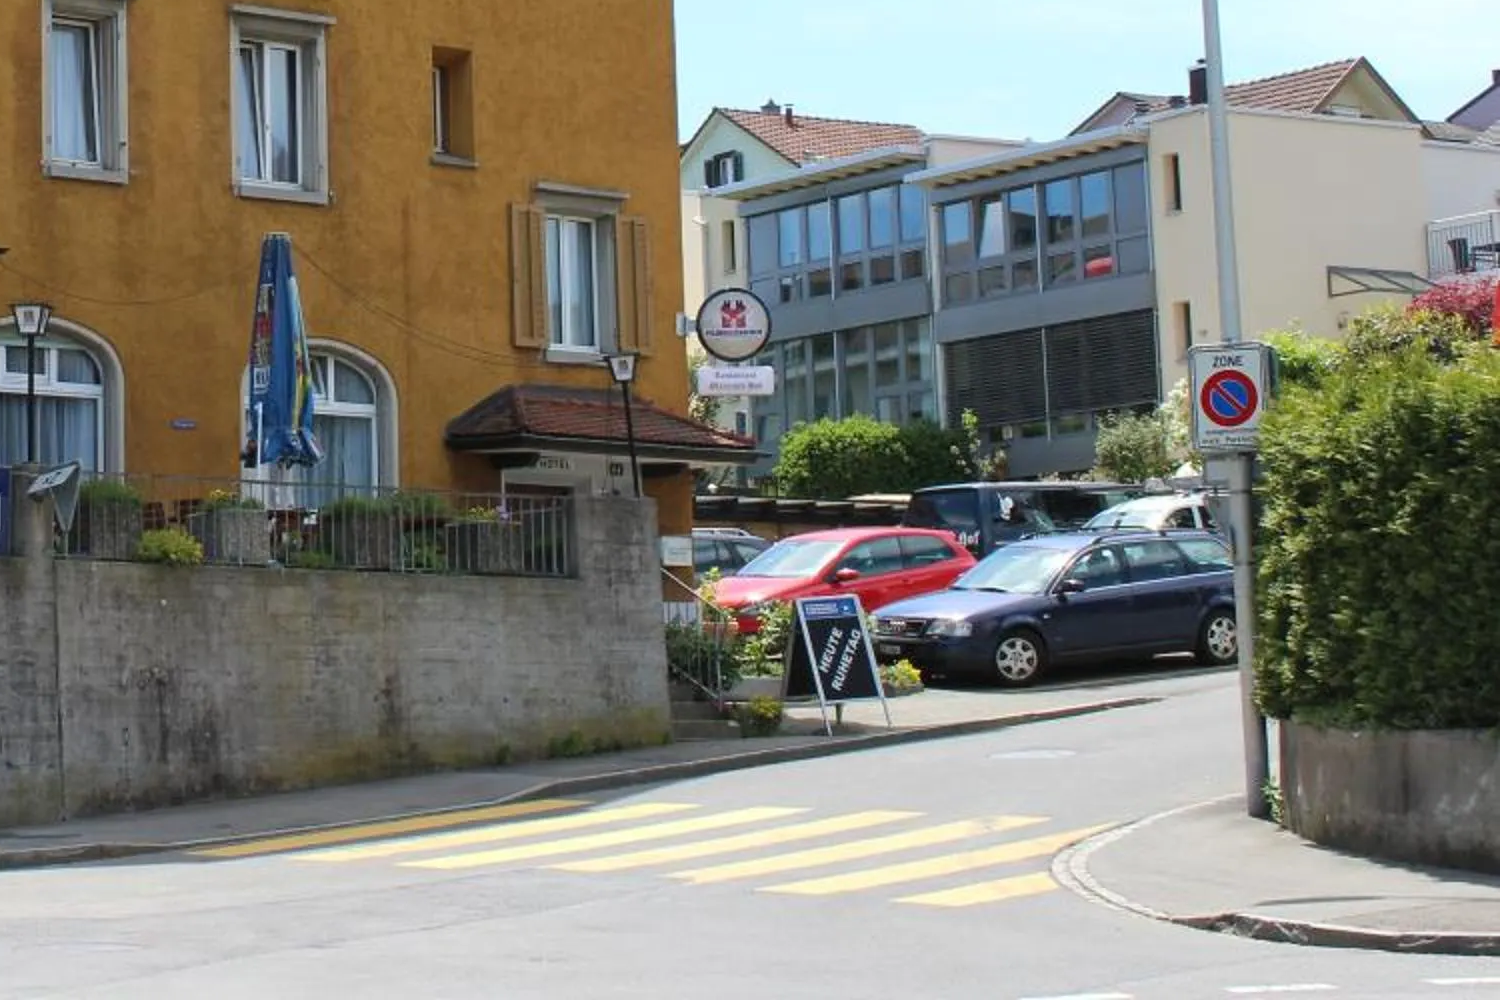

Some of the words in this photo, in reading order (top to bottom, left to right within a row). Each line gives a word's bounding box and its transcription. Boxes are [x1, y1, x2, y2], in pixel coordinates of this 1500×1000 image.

[1212, 355, 1244, 368] ZONE
[818, 626, 843, 673] HEUTE
[831, 628, 861, 692] RUHETAG
